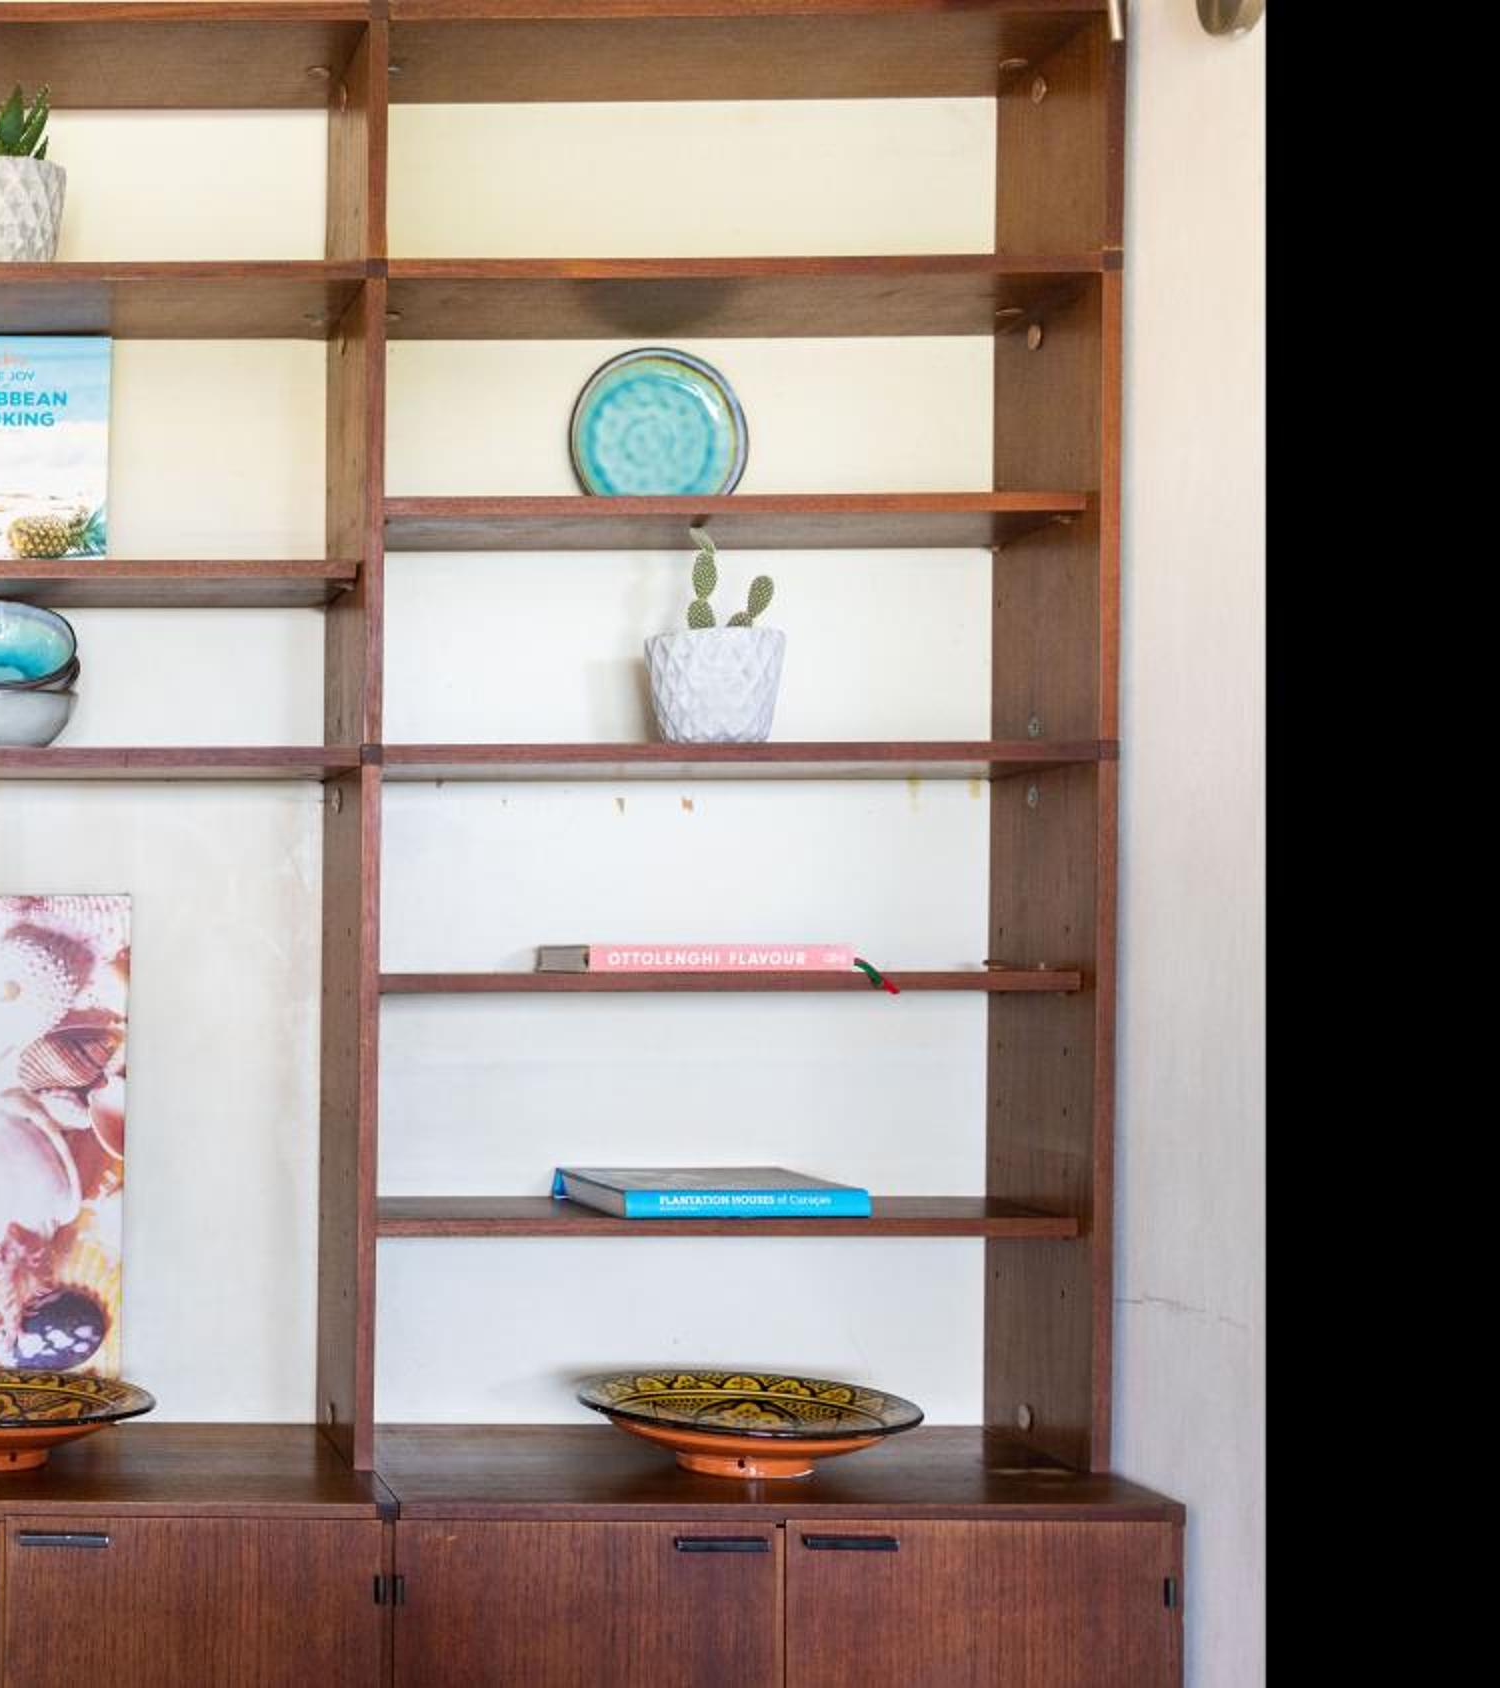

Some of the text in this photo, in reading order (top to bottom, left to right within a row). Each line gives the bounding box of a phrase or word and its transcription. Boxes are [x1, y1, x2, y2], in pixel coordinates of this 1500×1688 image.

[8, 370, 36, 381] JOY
[607, 951, 805, 966] OTTOLENGHI FLAVOUR
[659, 1195, 728, 1206] PLANTATION
[730, 1195, 775, 1206] HOUSES
